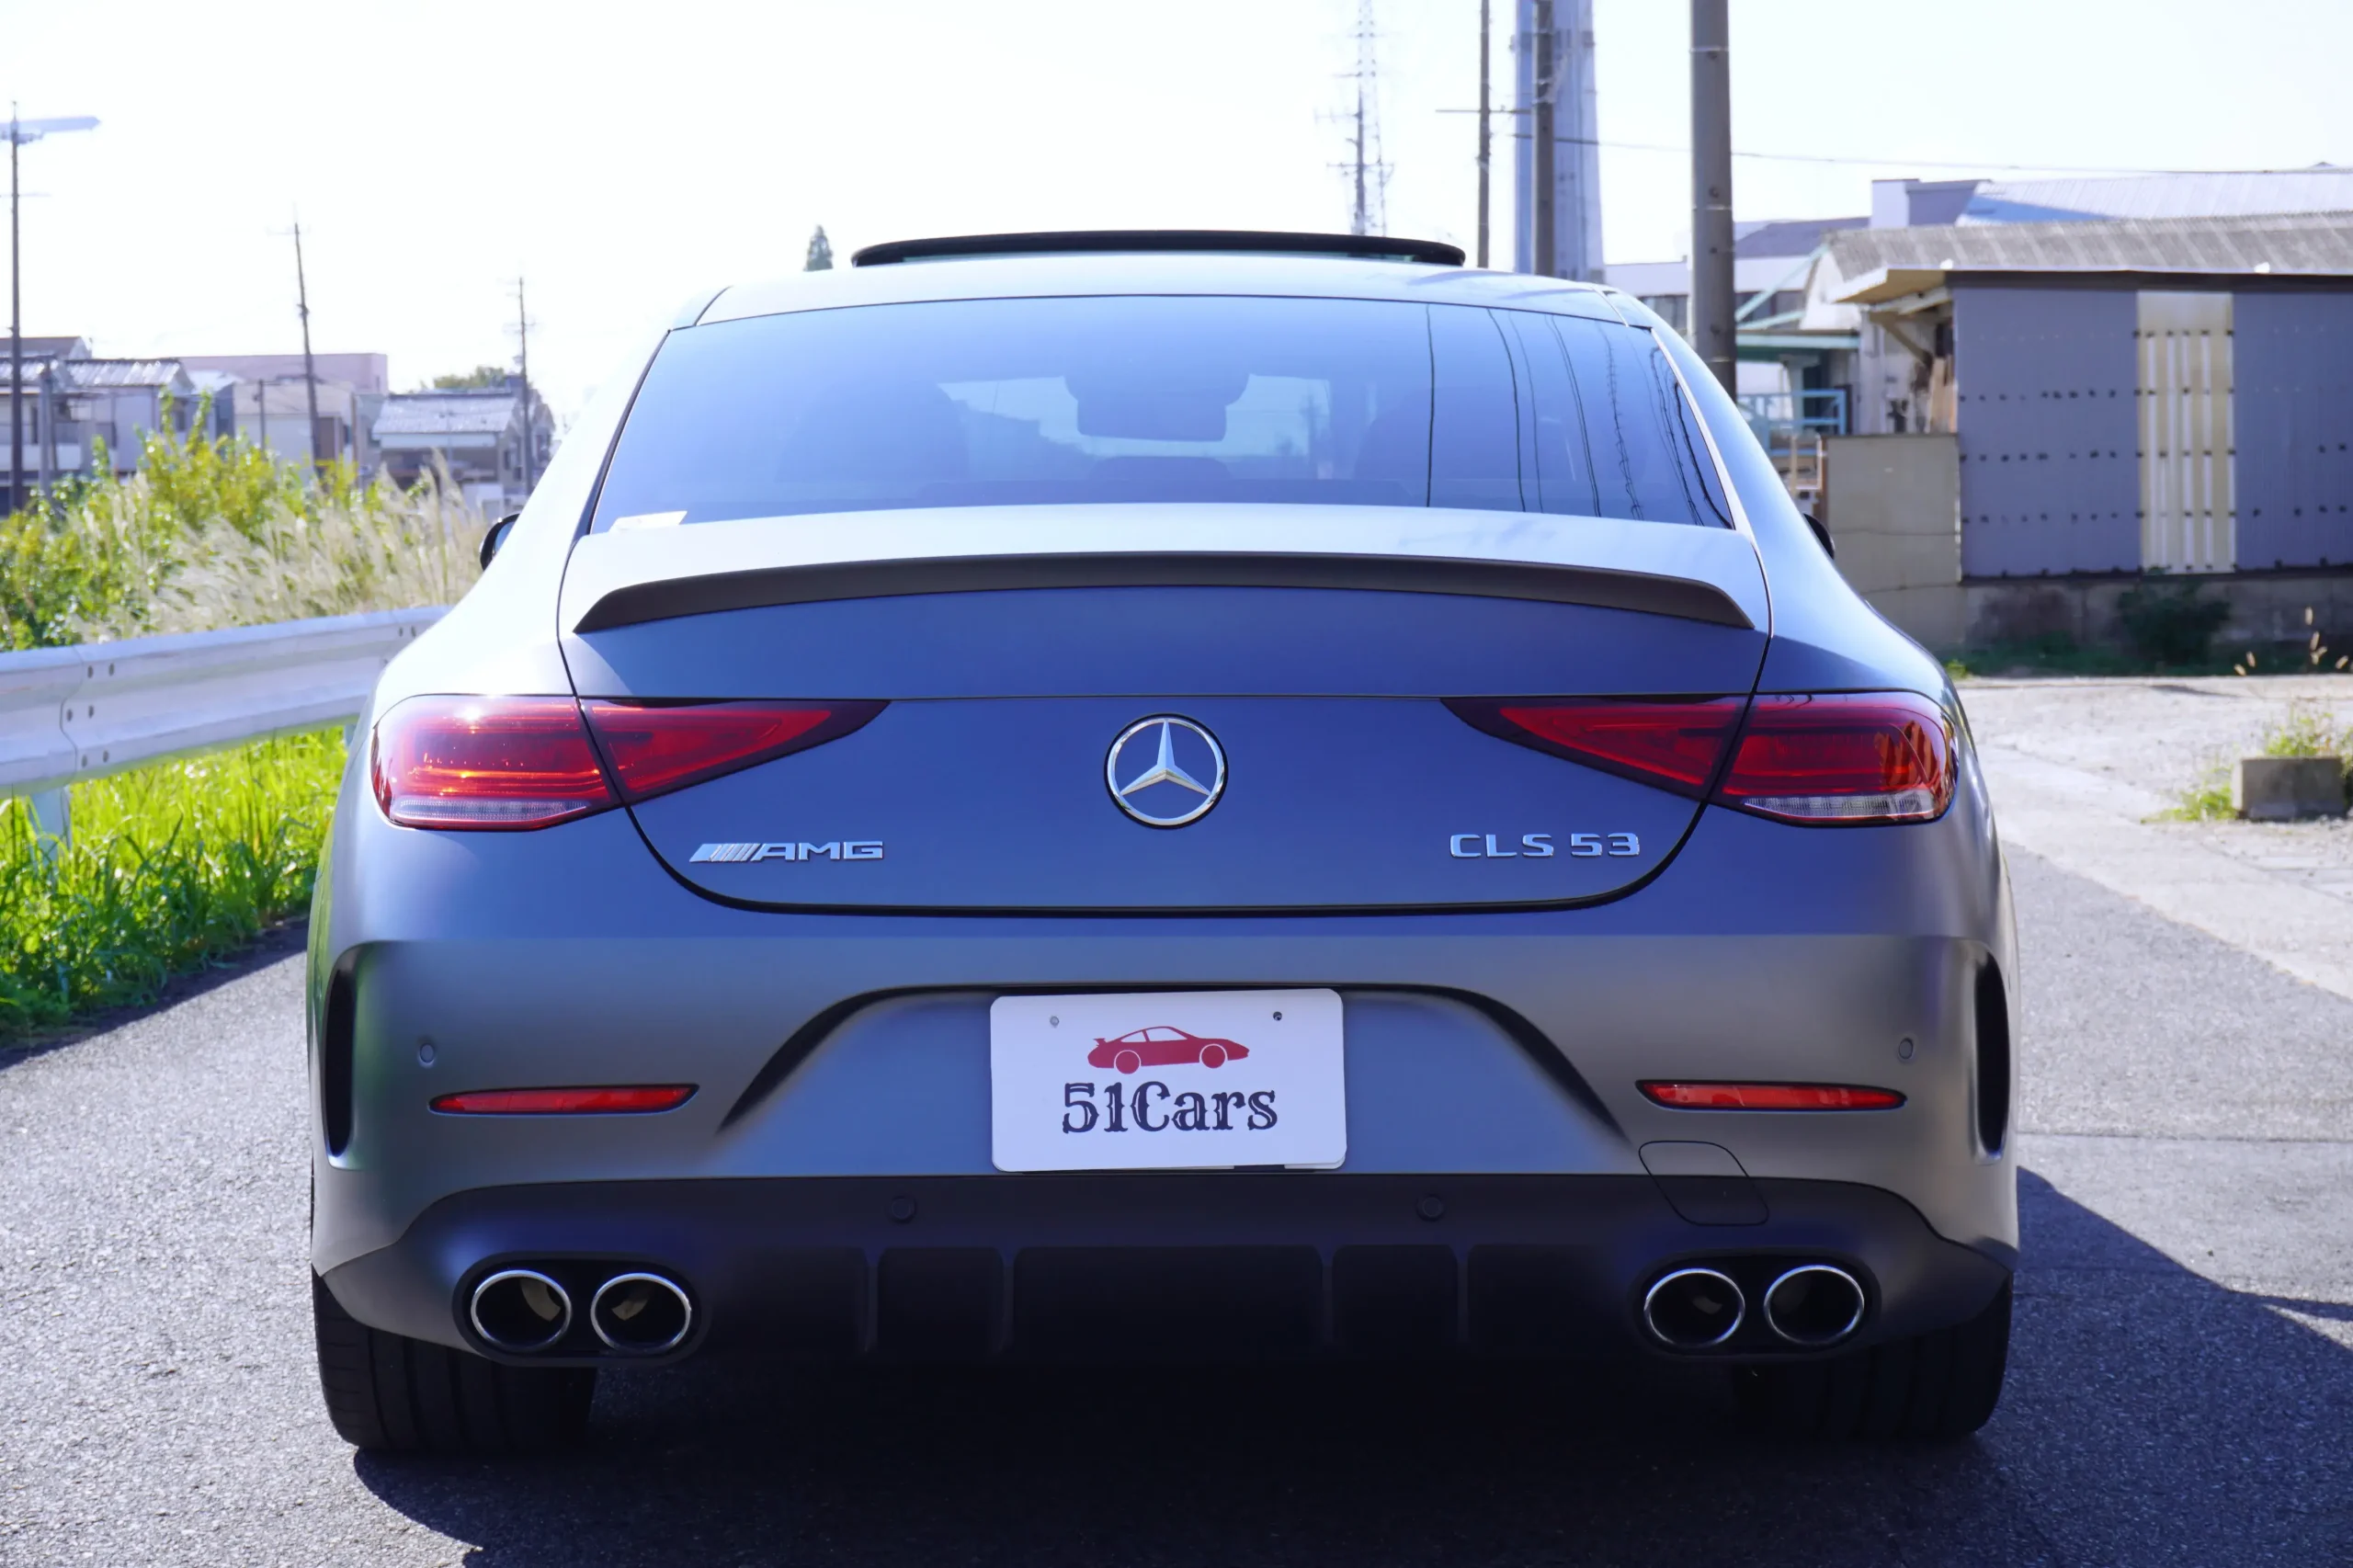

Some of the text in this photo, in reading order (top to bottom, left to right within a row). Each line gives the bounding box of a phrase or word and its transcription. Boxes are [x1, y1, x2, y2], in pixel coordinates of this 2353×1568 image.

[750, 841, 883, 862] AMG
[1449, 832, 1641, 858] CLS 53
[1062, 1081, 1279, 1134] 51Cars
